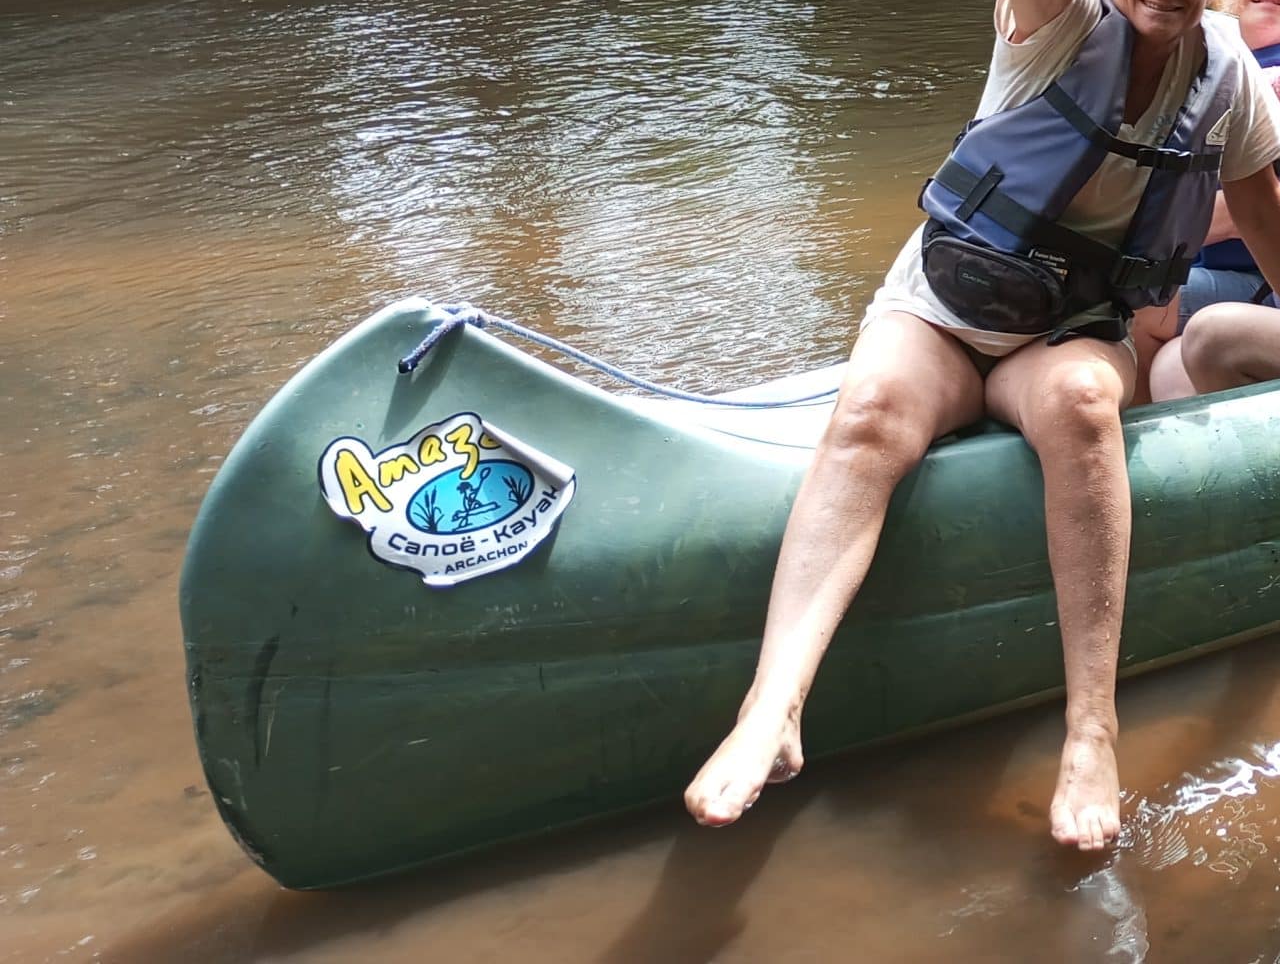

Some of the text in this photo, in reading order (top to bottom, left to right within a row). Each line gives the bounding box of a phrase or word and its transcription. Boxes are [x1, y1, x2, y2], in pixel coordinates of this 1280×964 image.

[387, 532, 476, 557] Canoë
[493, 484, 560, 544] Kayak
[444, 540, 529, 575] ARCACHON
